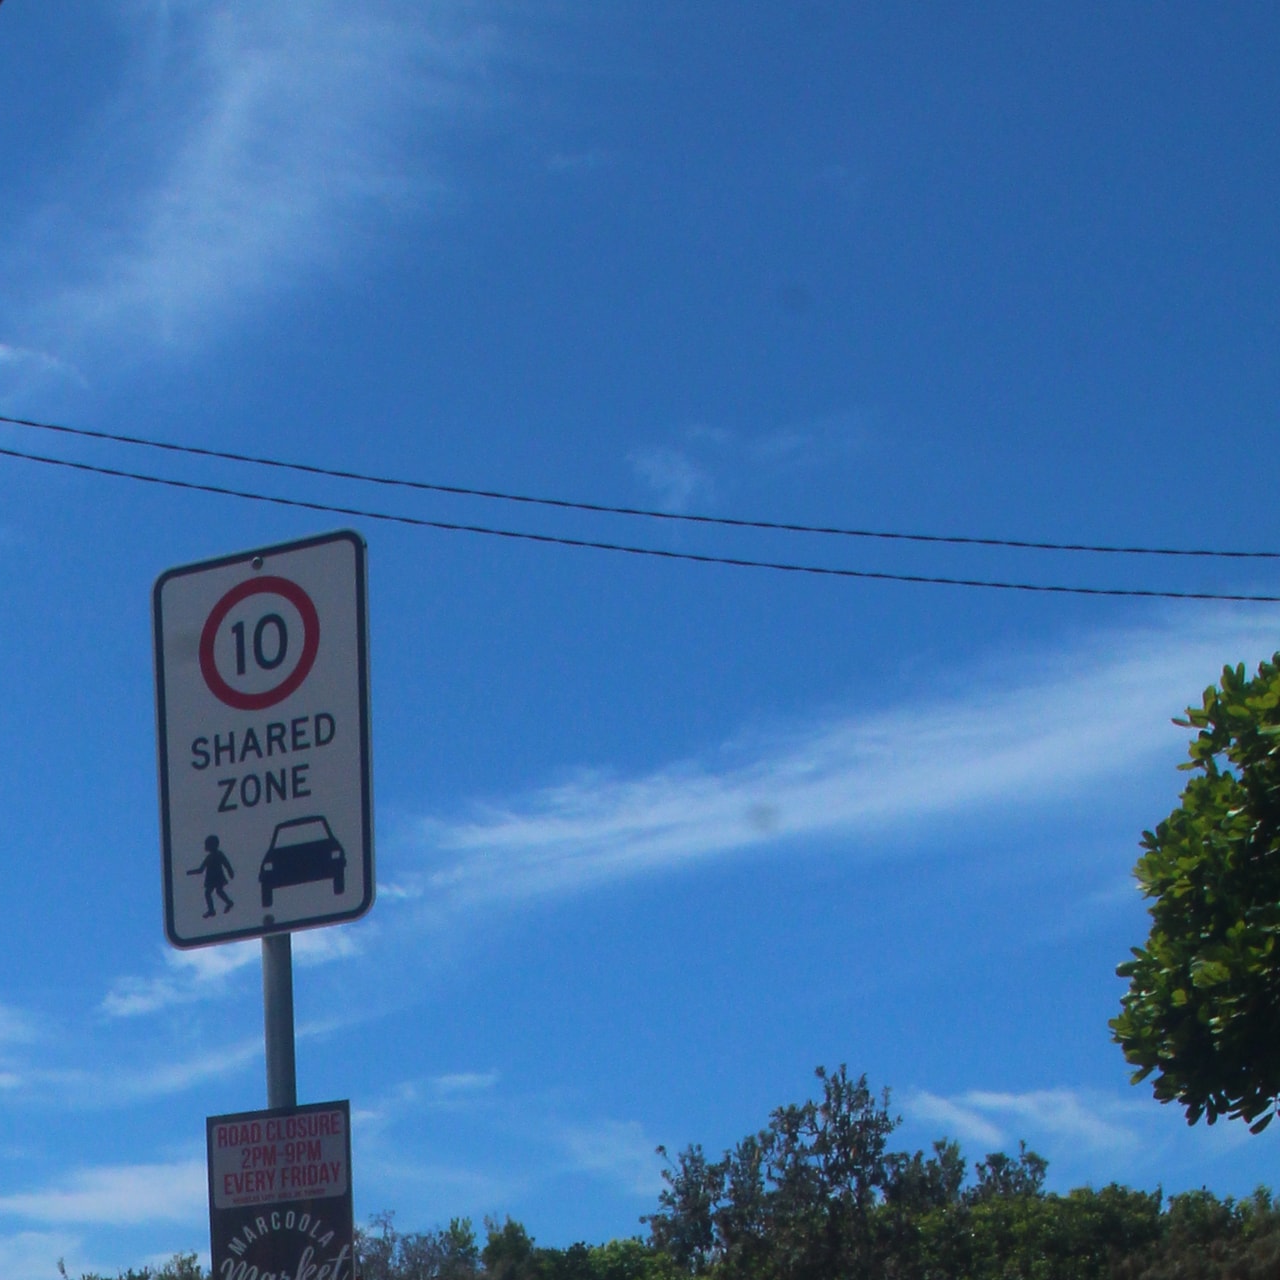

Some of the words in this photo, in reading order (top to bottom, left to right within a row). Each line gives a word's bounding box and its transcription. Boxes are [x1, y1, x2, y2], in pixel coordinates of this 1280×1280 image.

[231, 613, 288, 676] 10
[190, 712, 337, 770] SHARED
[217, 763, 312, 813] ZONE
[217, 1122, 262, 1148] ROAD
[266, 1112, 342, 1142] CLOSURE
[223, 1168, 276, 1195] EVERY
[281, 1161, 341, 1188] FRIDAY
[227, 1210, 335, 1257] MARCOOLA
